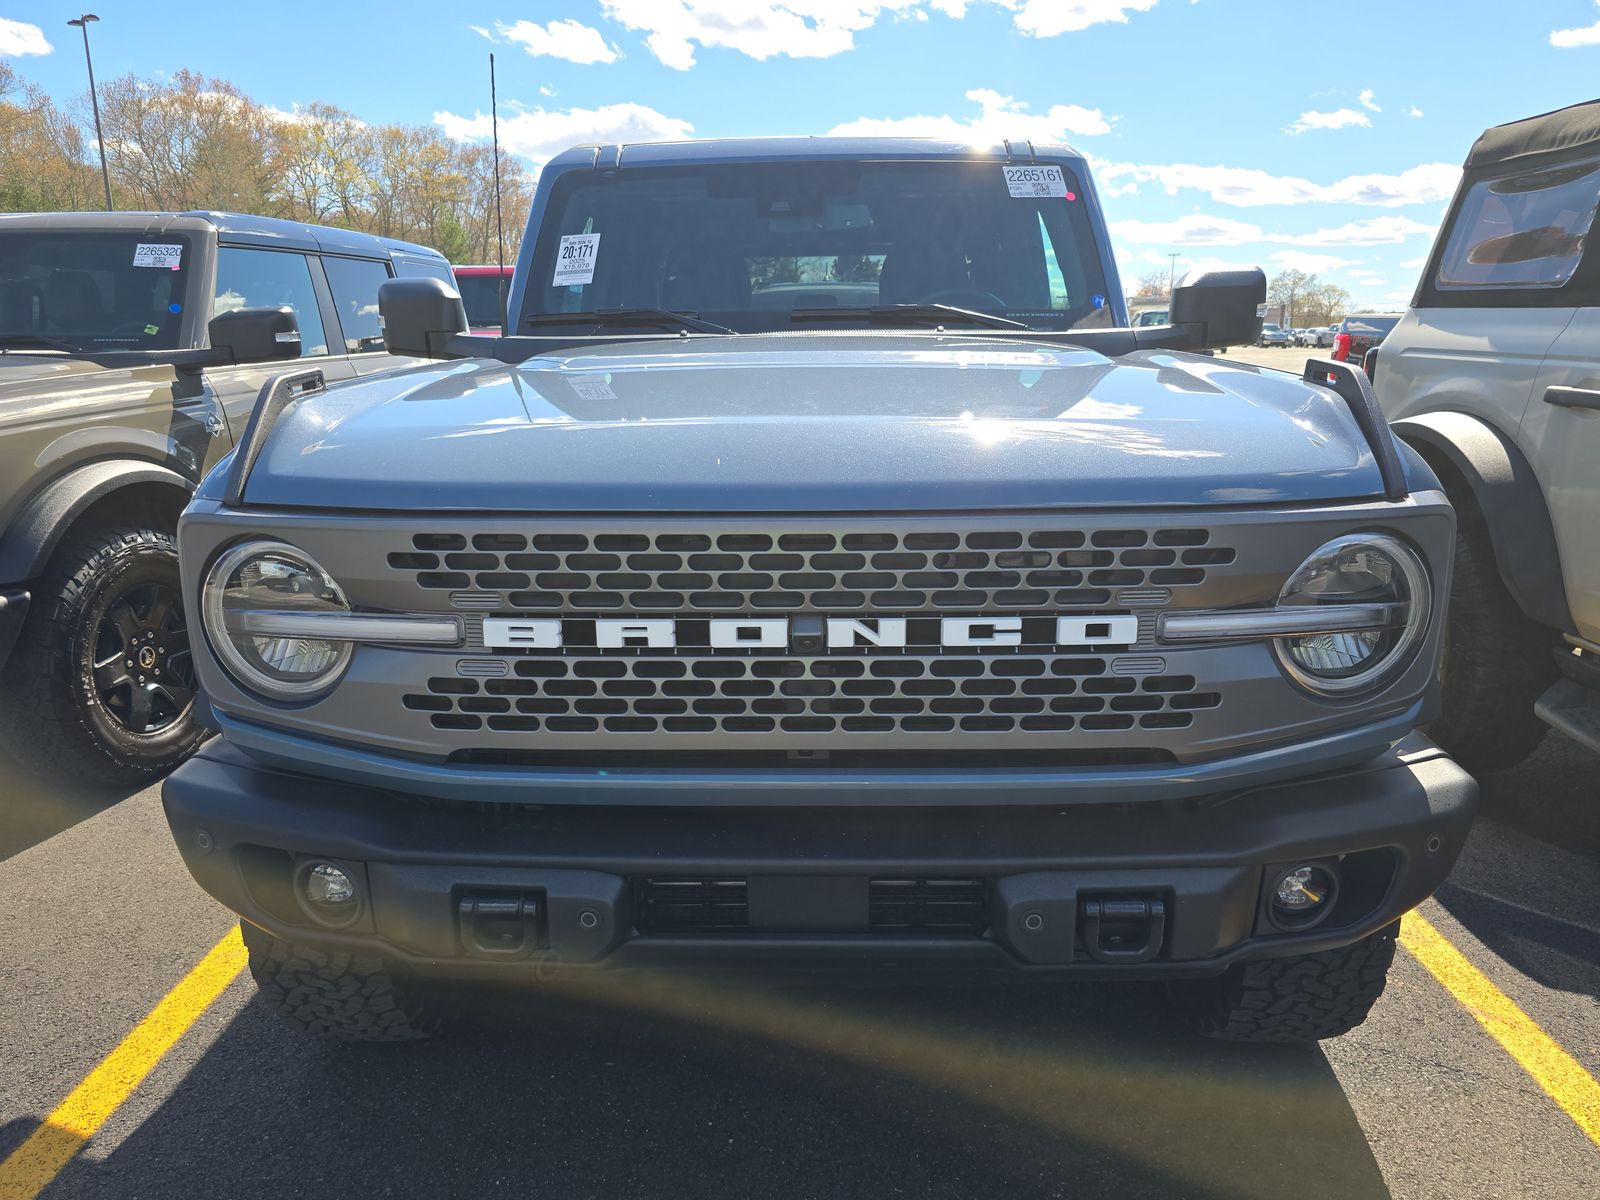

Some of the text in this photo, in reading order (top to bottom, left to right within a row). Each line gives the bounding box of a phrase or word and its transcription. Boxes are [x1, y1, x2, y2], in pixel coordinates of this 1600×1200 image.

[1006, 169, 1062, 182] 2265161
[137, 246, 182, 256] 2265320
[562, 243, 594, 259] 20:171
[482, 616, 1138, 648] BRONCO
